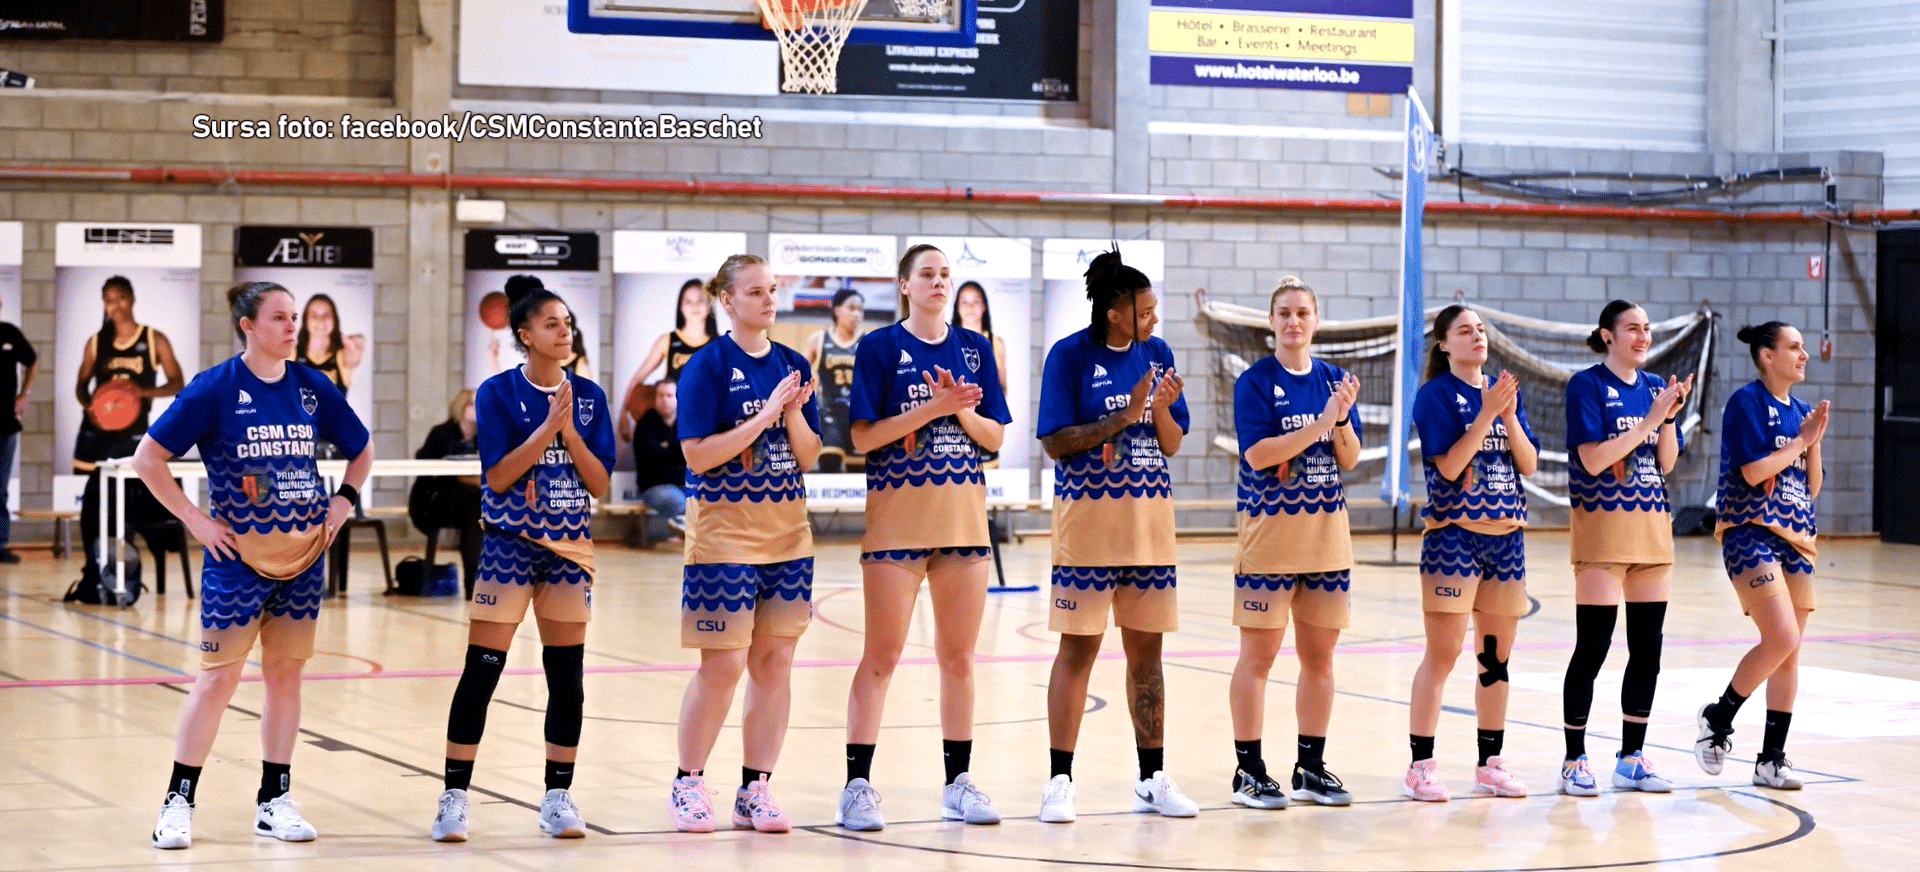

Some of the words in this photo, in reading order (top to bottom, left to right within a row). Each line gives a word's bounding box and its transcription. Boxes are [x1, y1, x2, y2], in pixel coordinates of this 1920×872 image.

[1232, 20, 1291, 35] Brasserie
[1309, 23, 1377, 39] Restaurant
[1196, 35, 1217, 48] Bar
[1237, 37, 1279, 51] Events
[1298, 40, 1357, 56] Meetings
[1194, 63, 1360, 84] www.hotelwaterloo.be
[246, 424, 285, 441] CSM
[286, 424, 314, 440] CSU
[1750, 572, 1775, 588] CSU
[1435, 586, 1462, 598] CSU
[475, 593, 497, 606] CSU
[1055, 598, 1077, 611] CSU
[1244, 600, 1268, 612] CSU
[696, 619, 726, 632] CSU
